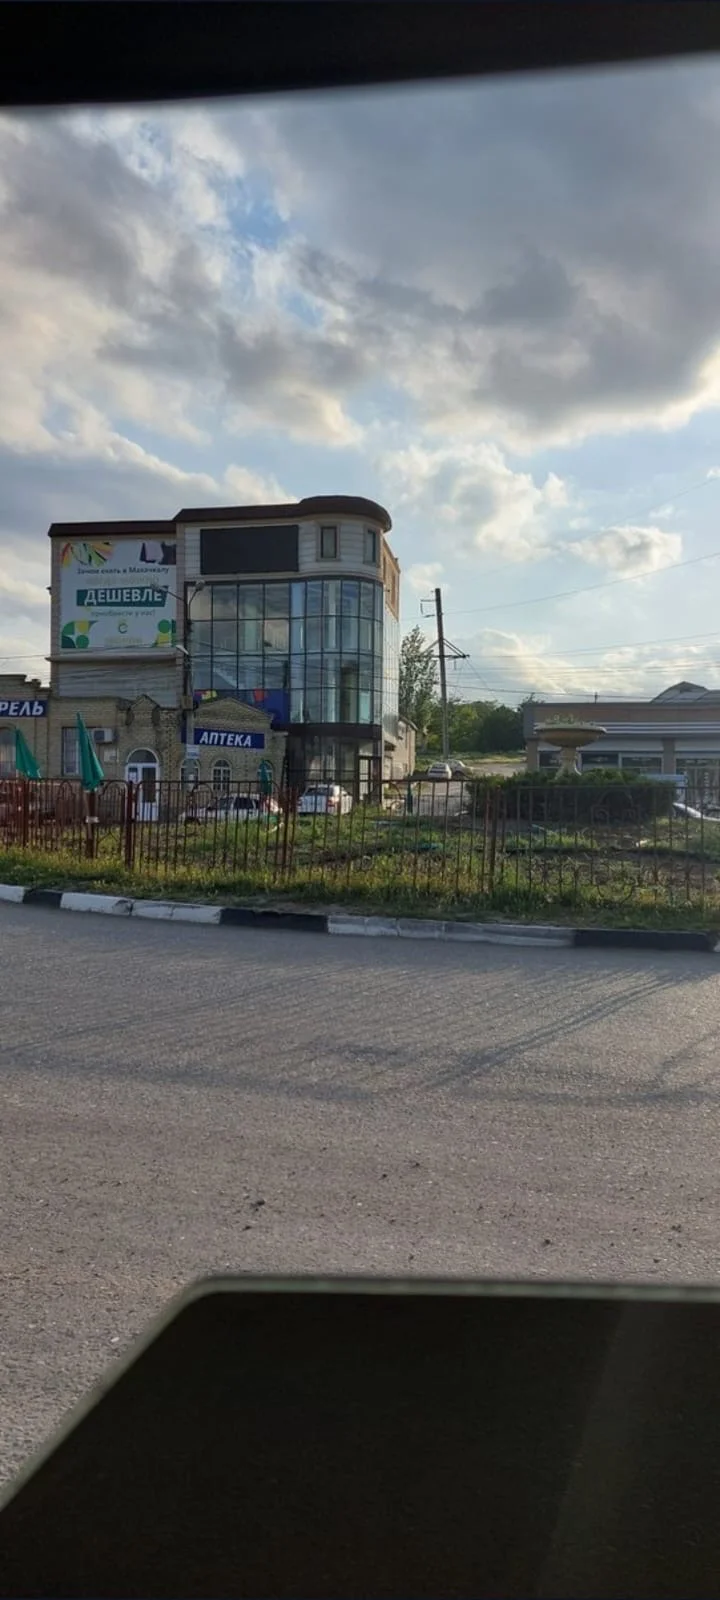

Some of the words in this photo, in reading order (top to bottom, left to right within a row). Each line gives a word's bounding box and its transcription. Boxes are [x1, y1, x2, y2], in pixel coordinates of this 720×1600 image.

[128, 566, 169, 574] Махачкалу
[84, 589, 162, 606] ДЕШЕВЛЕ
[0, 701, 44, 716] РЕЛЬ
[199, 731, 252, 747] АПТЕКА
